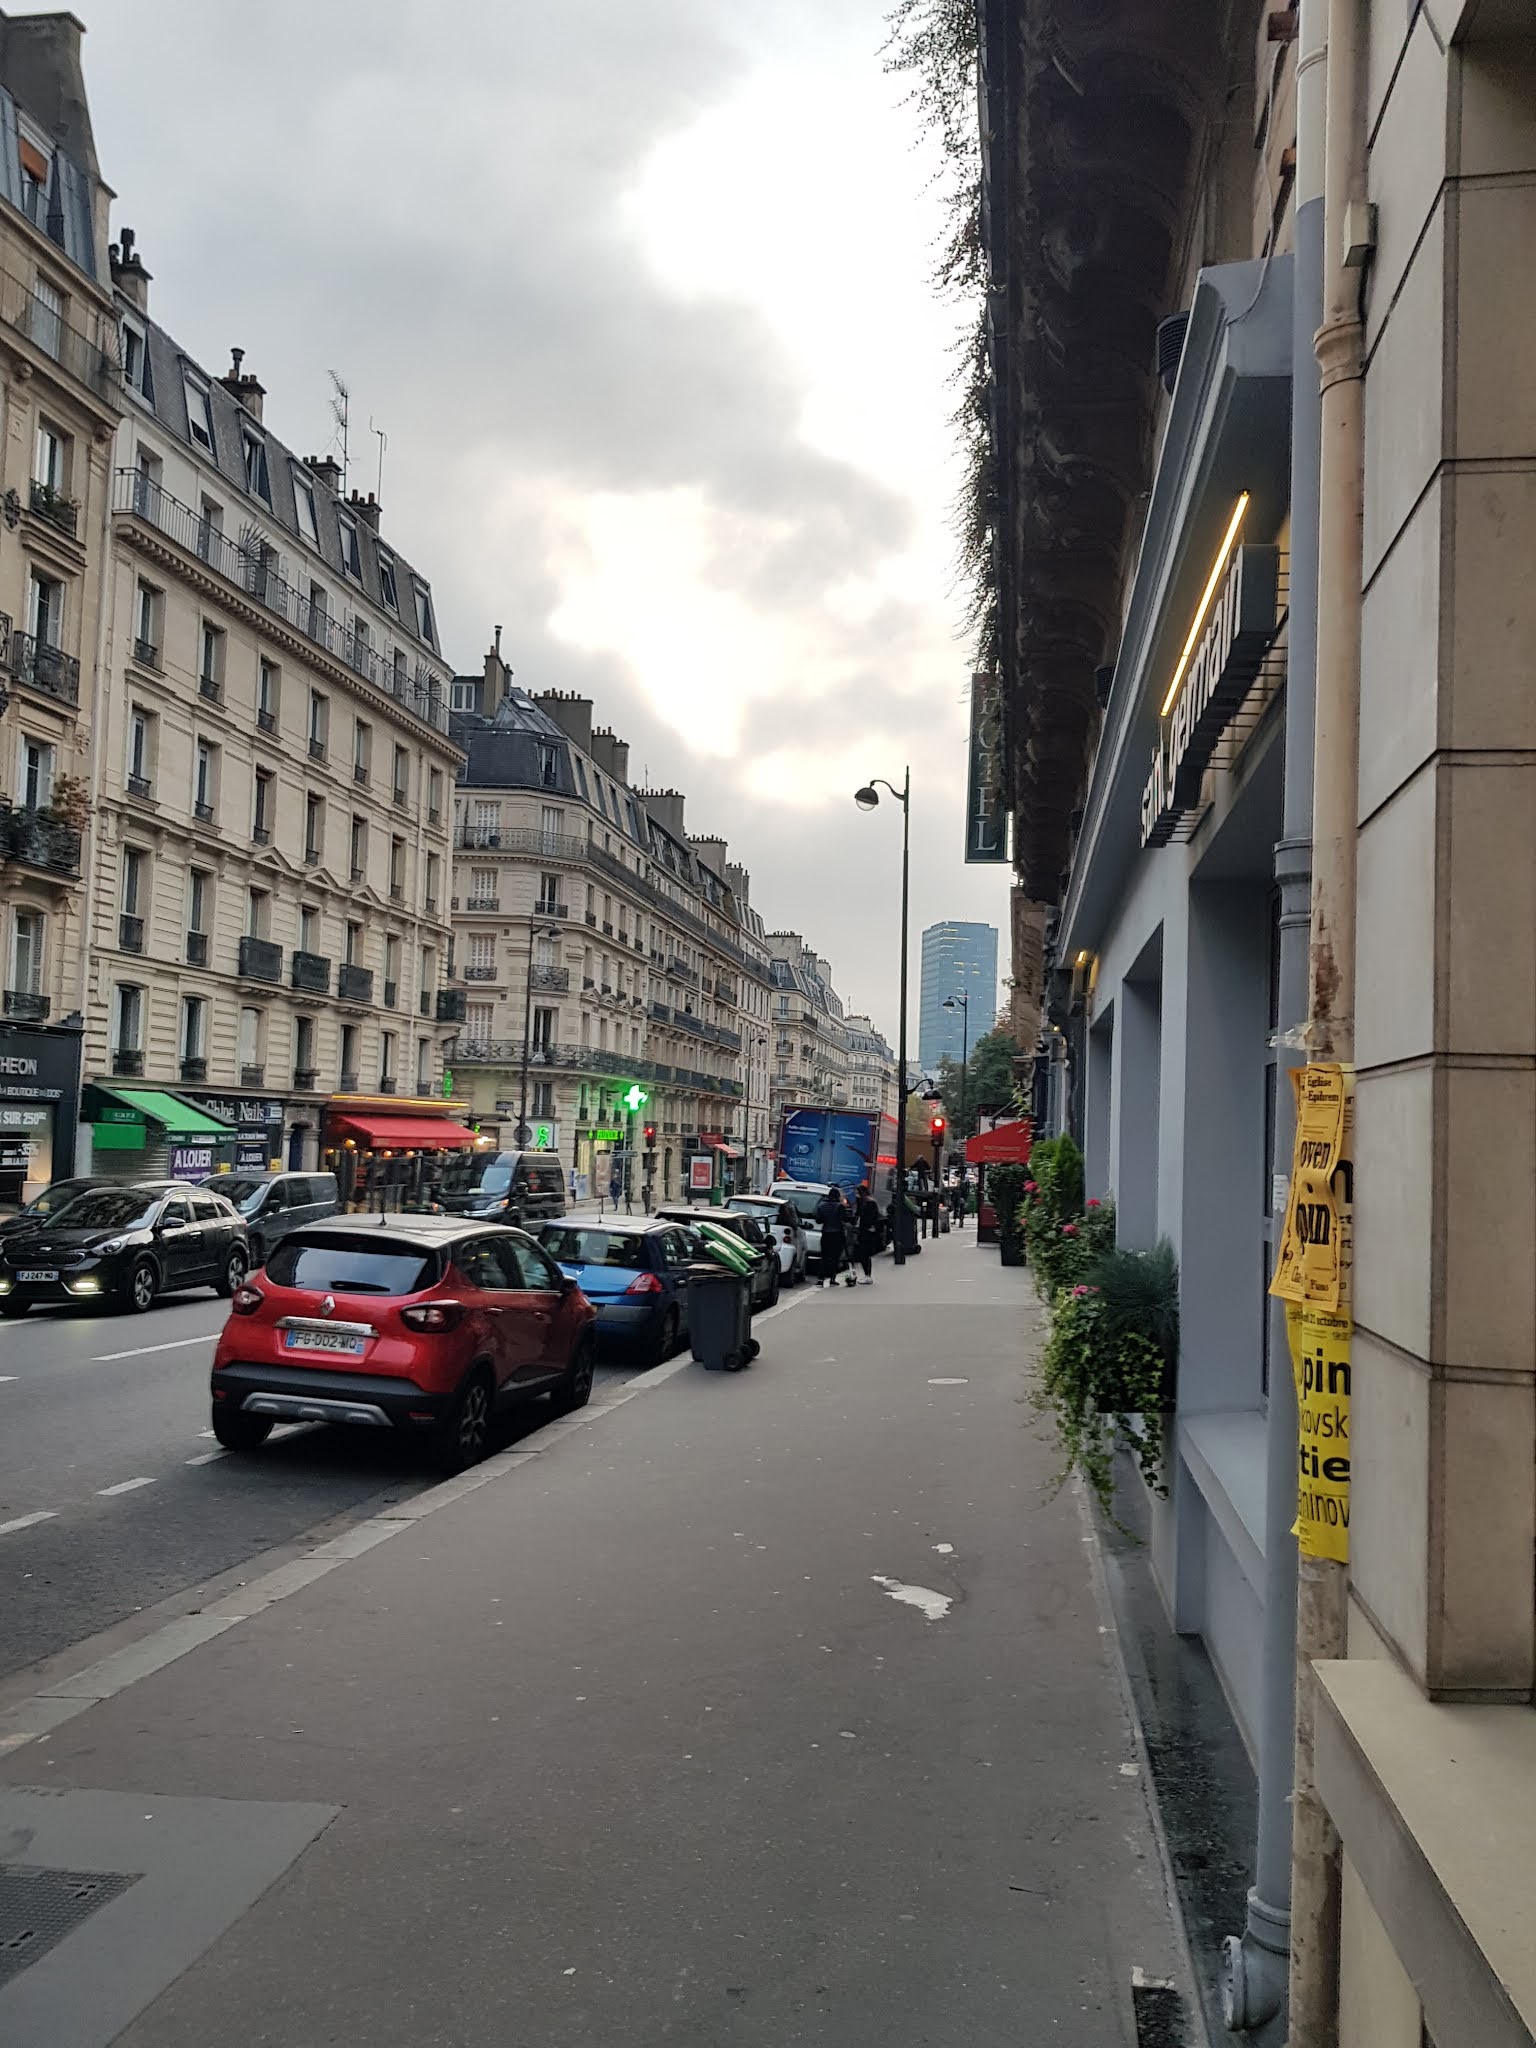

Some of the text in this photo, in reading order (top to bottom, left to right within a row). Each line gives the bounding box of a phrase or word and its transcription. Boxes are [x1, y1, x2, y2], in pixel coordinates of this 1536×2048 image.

[1167, 545, 1243, 811] germain
[239, 1102, 265, 1121] Nails
[182, 1149, 212, 1168] LOUER
[1300, 1443, 1351, 1482] tie
